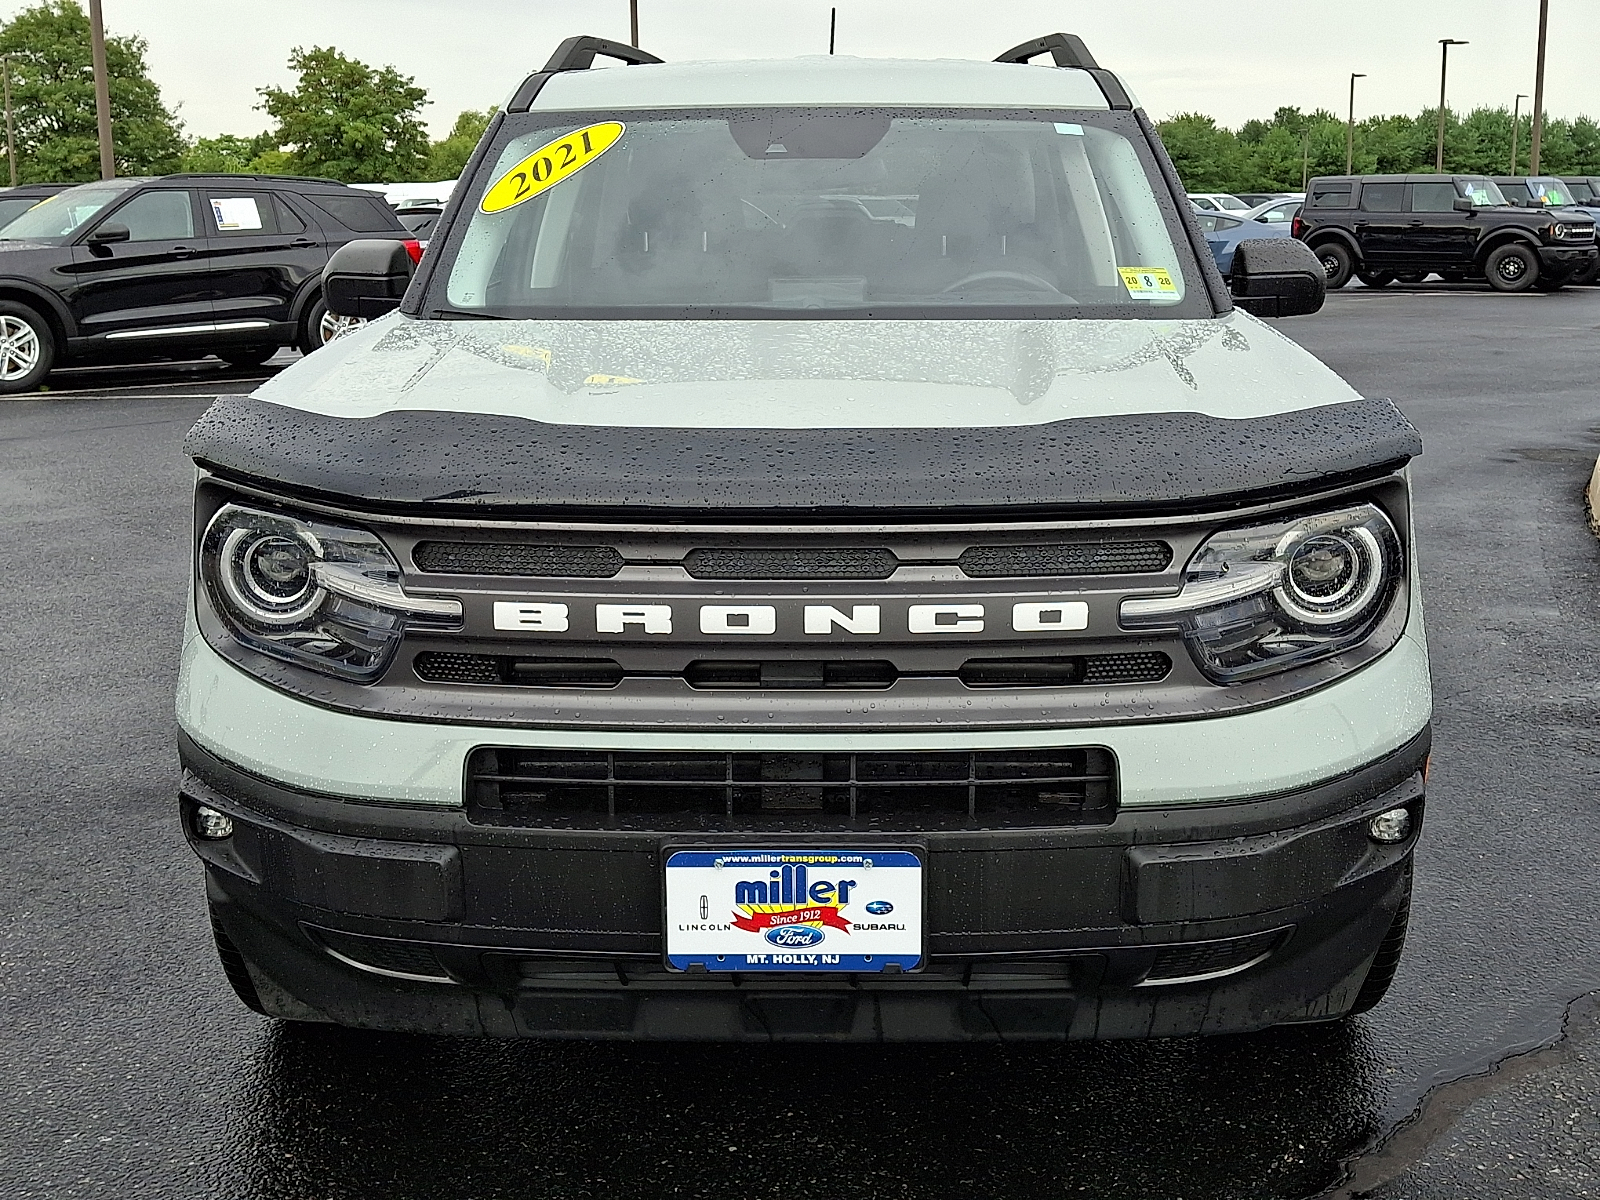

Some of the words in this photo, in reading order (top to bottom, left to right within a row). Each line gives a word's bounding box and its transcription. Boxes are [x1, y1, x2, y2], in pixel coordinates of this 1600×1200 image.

[510, 131, 595, 200] 2021
[1125, 276, 1138, 285] 20
[1143, 275, 1153, 287] 8
[493, 601, 1089, 635] BRONCO
[722, 854, 863, 864] www.millertransgroup.com
[735, 864, 857, 904] miller
[770, 914, 797, 925] Since
[799, 909, 821, 921] 1912
[852, 923, 906, 931] SUBARU
[776, 927, 815, 945] Ford
[746, 954, 769, 964] MT.
[772, 954, 818, 966] HOLLY,
[821, 954, 840, 964] NJ
